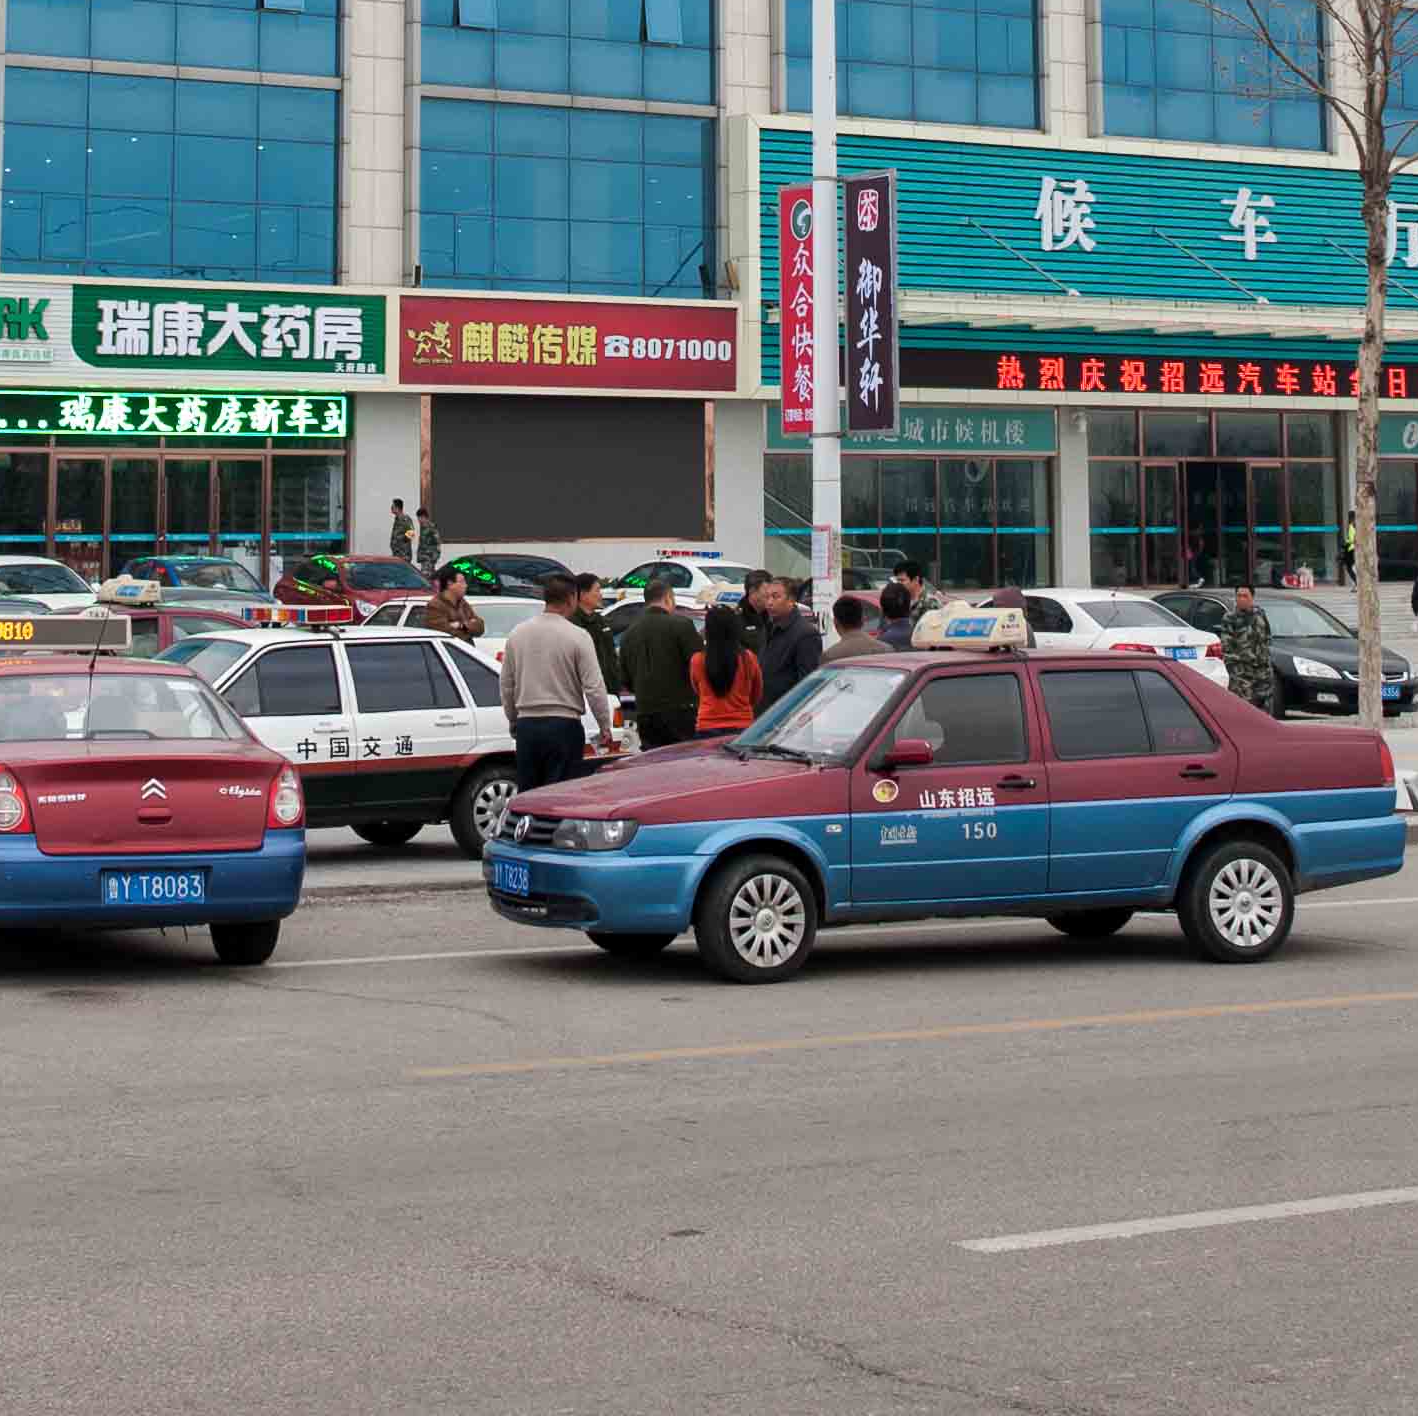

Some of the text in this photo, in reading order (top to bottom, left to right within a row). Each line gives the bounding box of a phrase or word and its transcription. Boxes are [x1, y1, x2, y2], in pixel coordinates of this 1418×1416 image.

[96, 298, 364, 361] 瑞康大药房
[462, 321, 732, 366] 麒麟传媒 8071000
[789, 241, 813, 403] 众合快餐
[856, 257, 884, 414] 御华轩
[296, 735, 414, 761] 中国交通
[919, 786, 996, 809] 山东招远
[962, 822, 998, 841] 150
